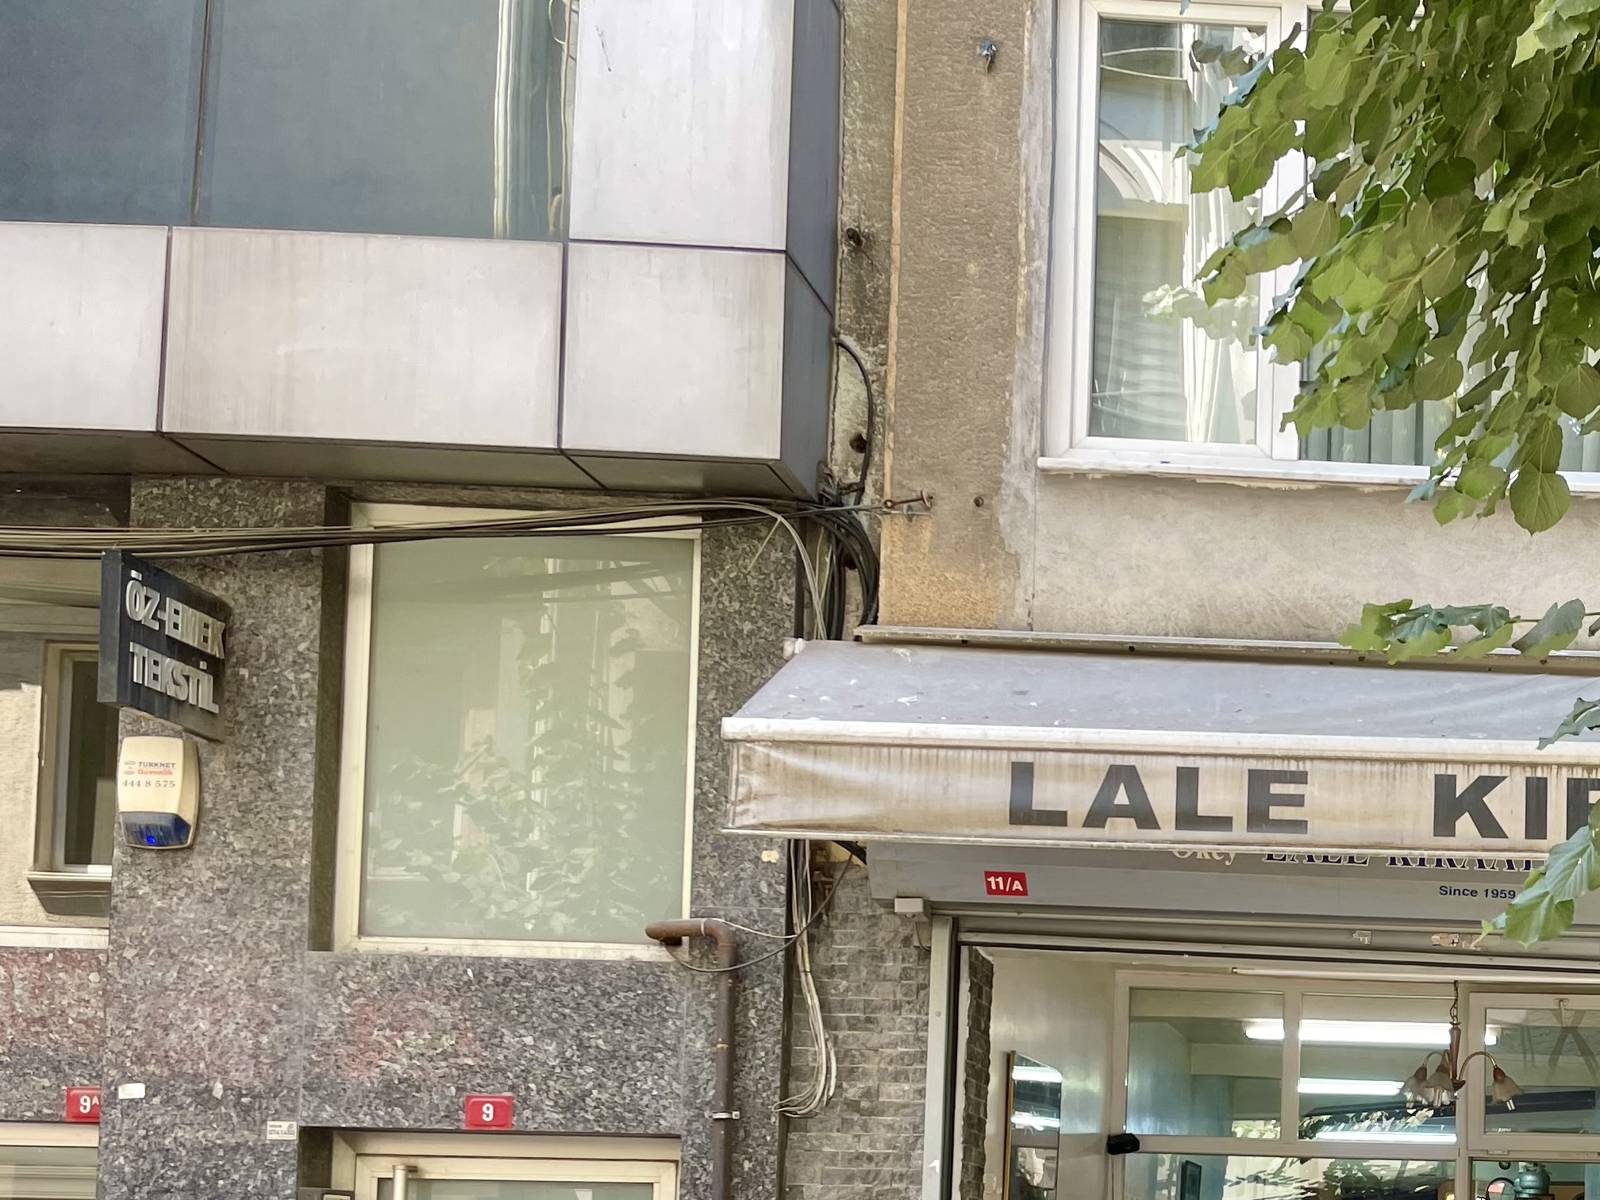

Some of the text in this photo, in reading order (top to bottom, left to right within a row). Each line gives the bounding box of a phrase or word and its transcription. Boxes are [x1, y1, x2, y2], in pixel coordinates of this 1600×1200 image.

[126, 569, 226, 659] ÖZ-EMEK
[129, 641, 220, 714] TEKSTİL
[1008, 761, 1308, 834] LALE
[986, 876, 1024, 892] 11/A
[1438, 885, 1516, 900] Since 1959
[481, 1103, 494, 1121] 9
